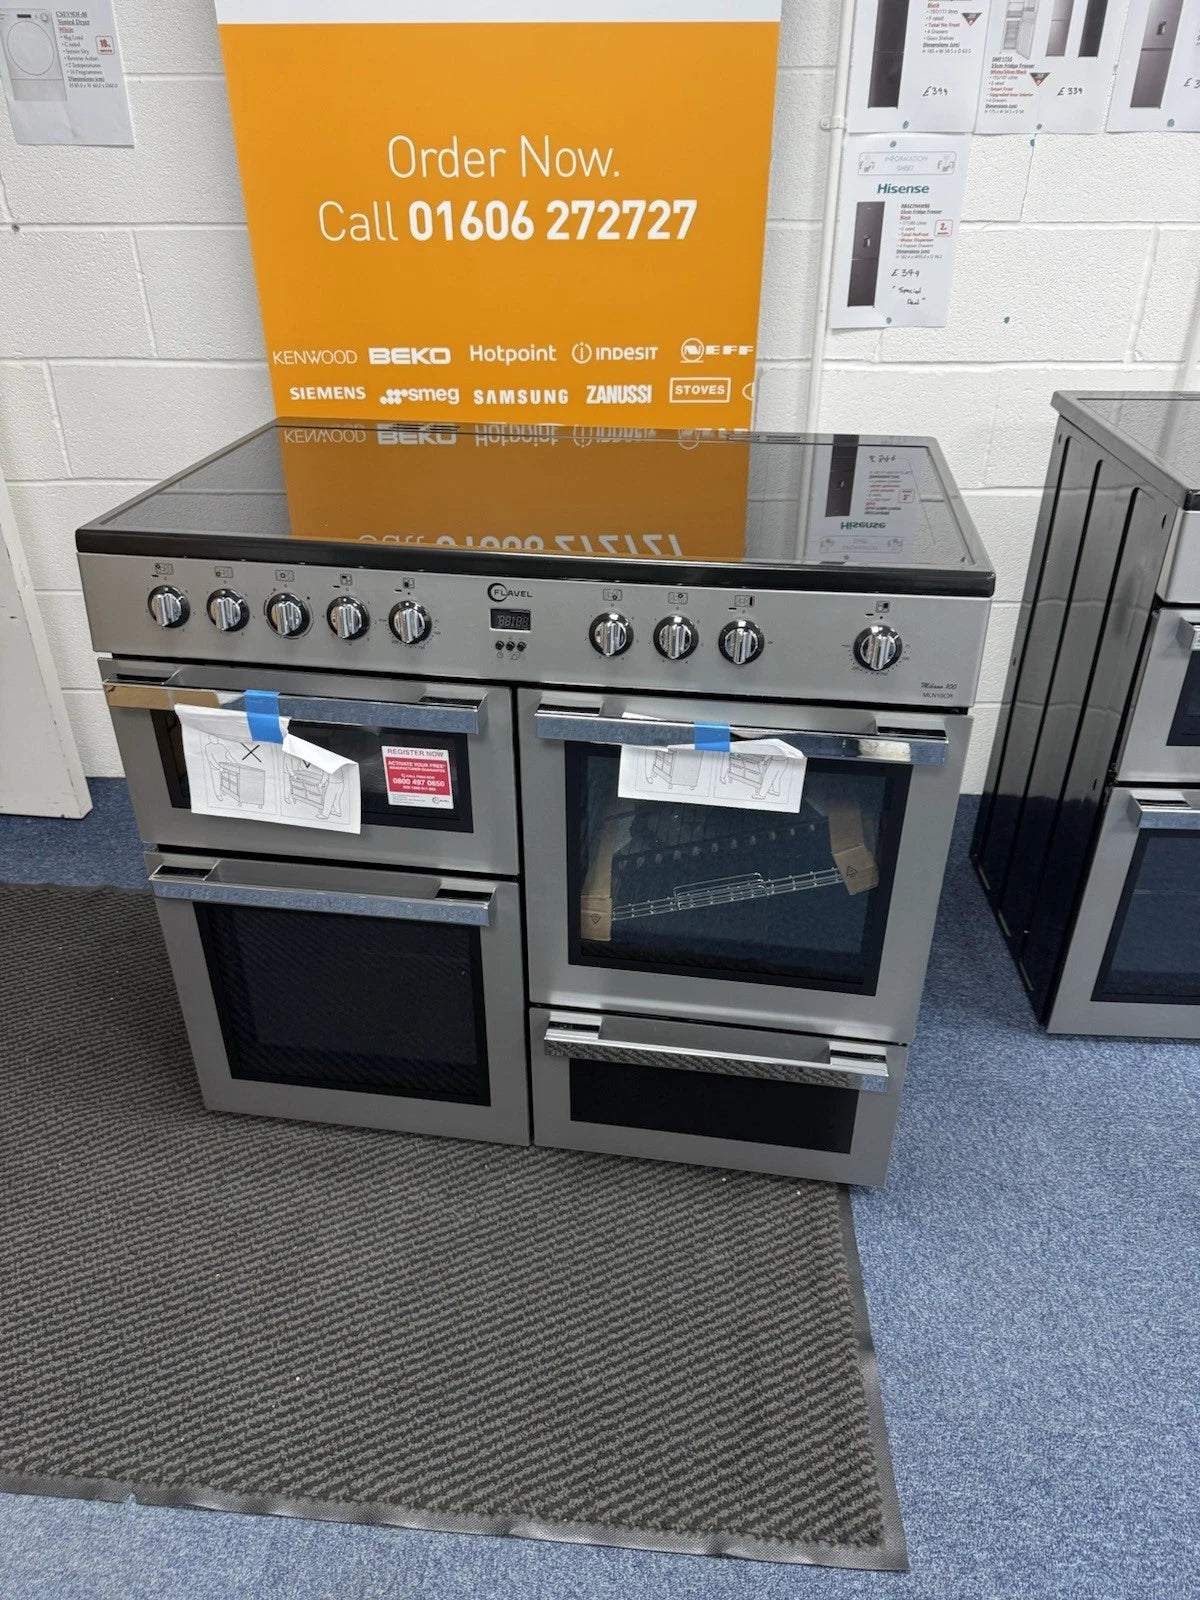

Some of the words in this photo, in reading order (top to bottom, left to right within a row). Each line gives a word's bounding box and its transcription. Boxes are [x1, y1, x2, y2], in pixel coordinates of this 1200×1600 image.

[388, 134, 507, 179] Order
[520, 134, 620, 178] Now.
[877, 183, 930, 194] Hisense
[318, 200, 399, 241] Call
[408, 200, 535, 241] 01606
[546, 199, 698, 240] 272727
[272, 349, 358, 365] KENWOOD
[368, 347, 452, 365] BEKO
[469, 344, 557, 365] Hotpoint
[289, 386, 367, 400] SIEMENS
[408, 387, 460, 405] smeg
[473, 388, 569, 405] SAMSUNG
[586, 384, 652, 404] ZANUSSI
[675, 385, 725, 395] STOVES
[493, 588, 533, 599] FLAVEL
[386, 748, 425, 756] REGISTER
